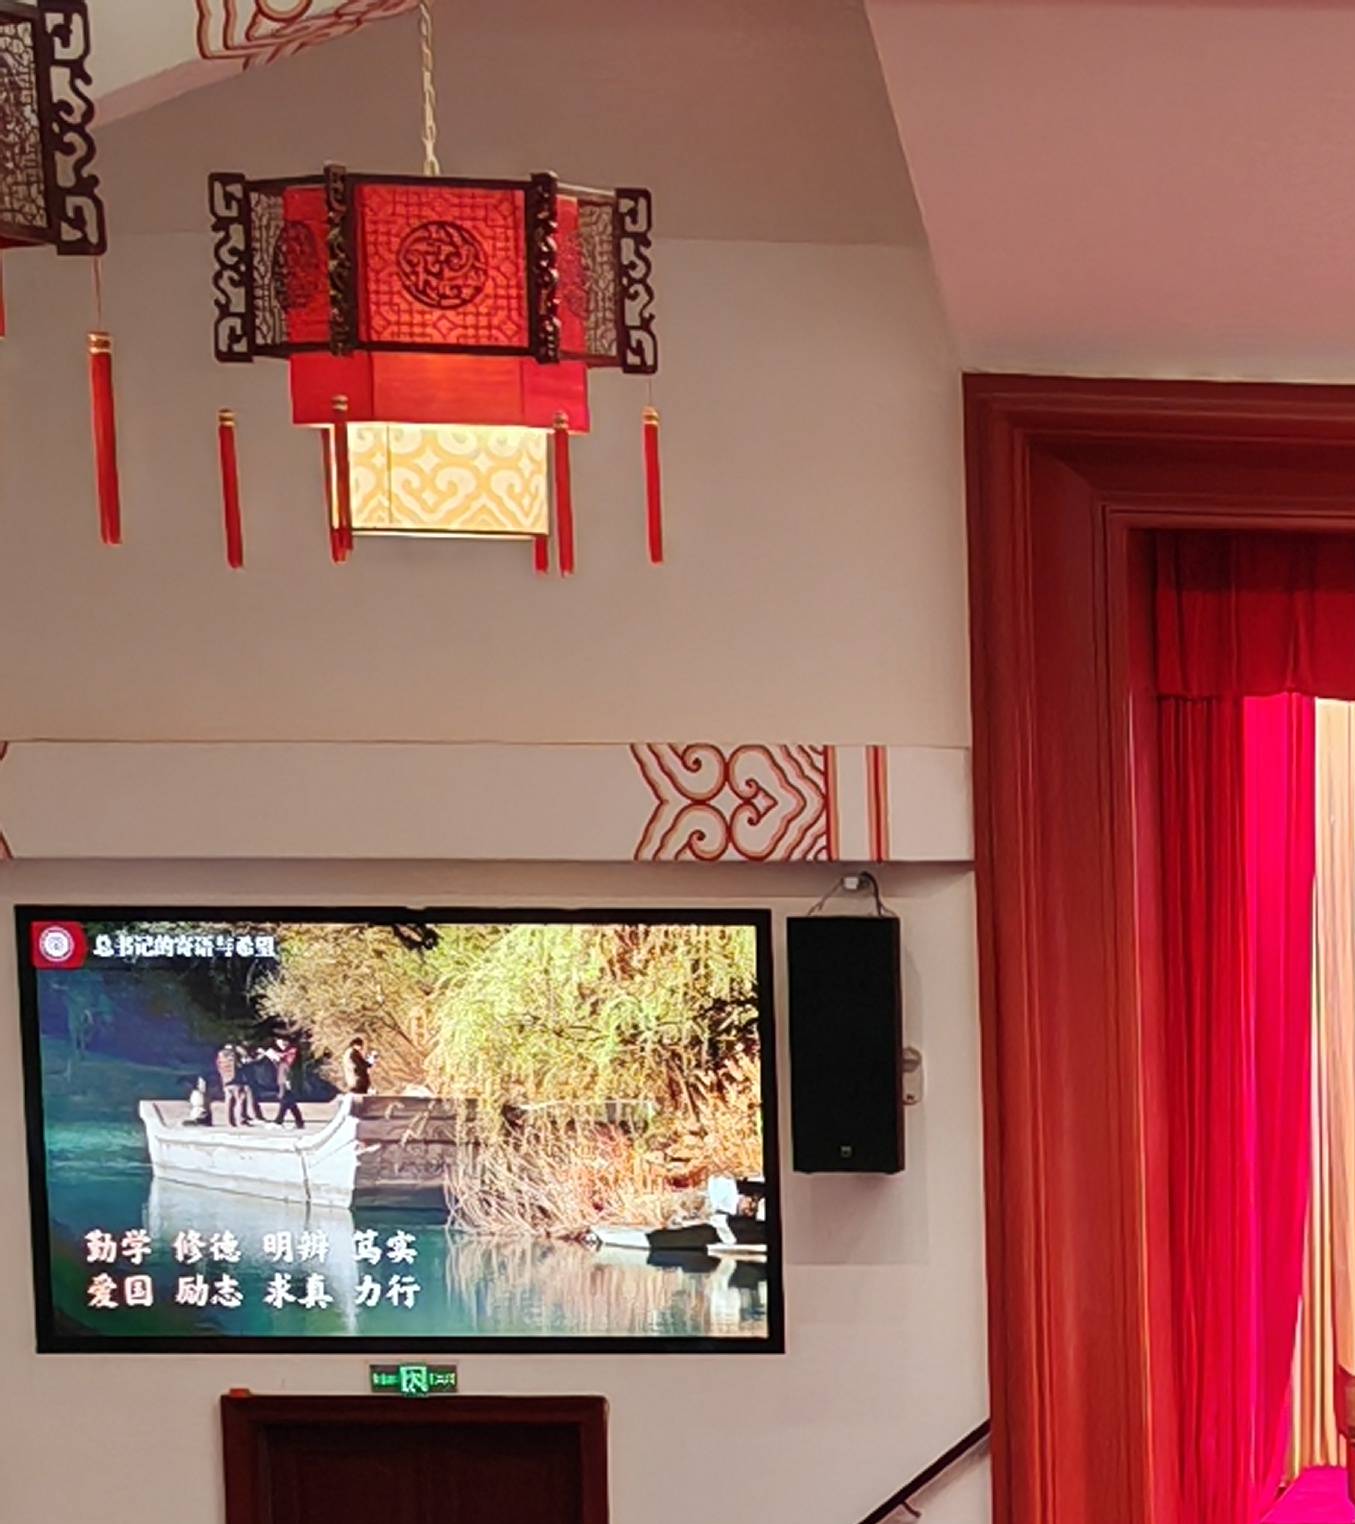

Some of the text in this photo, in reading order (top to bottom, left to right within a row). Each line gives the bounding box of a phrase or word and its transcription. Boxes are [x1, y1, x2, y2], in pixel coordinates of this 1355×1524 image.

[84, 1228, 418, 1264] 勤学 修德 明辨 笃实
[87, 1272, 421, 1309] 爱国 励志 求真 力行
